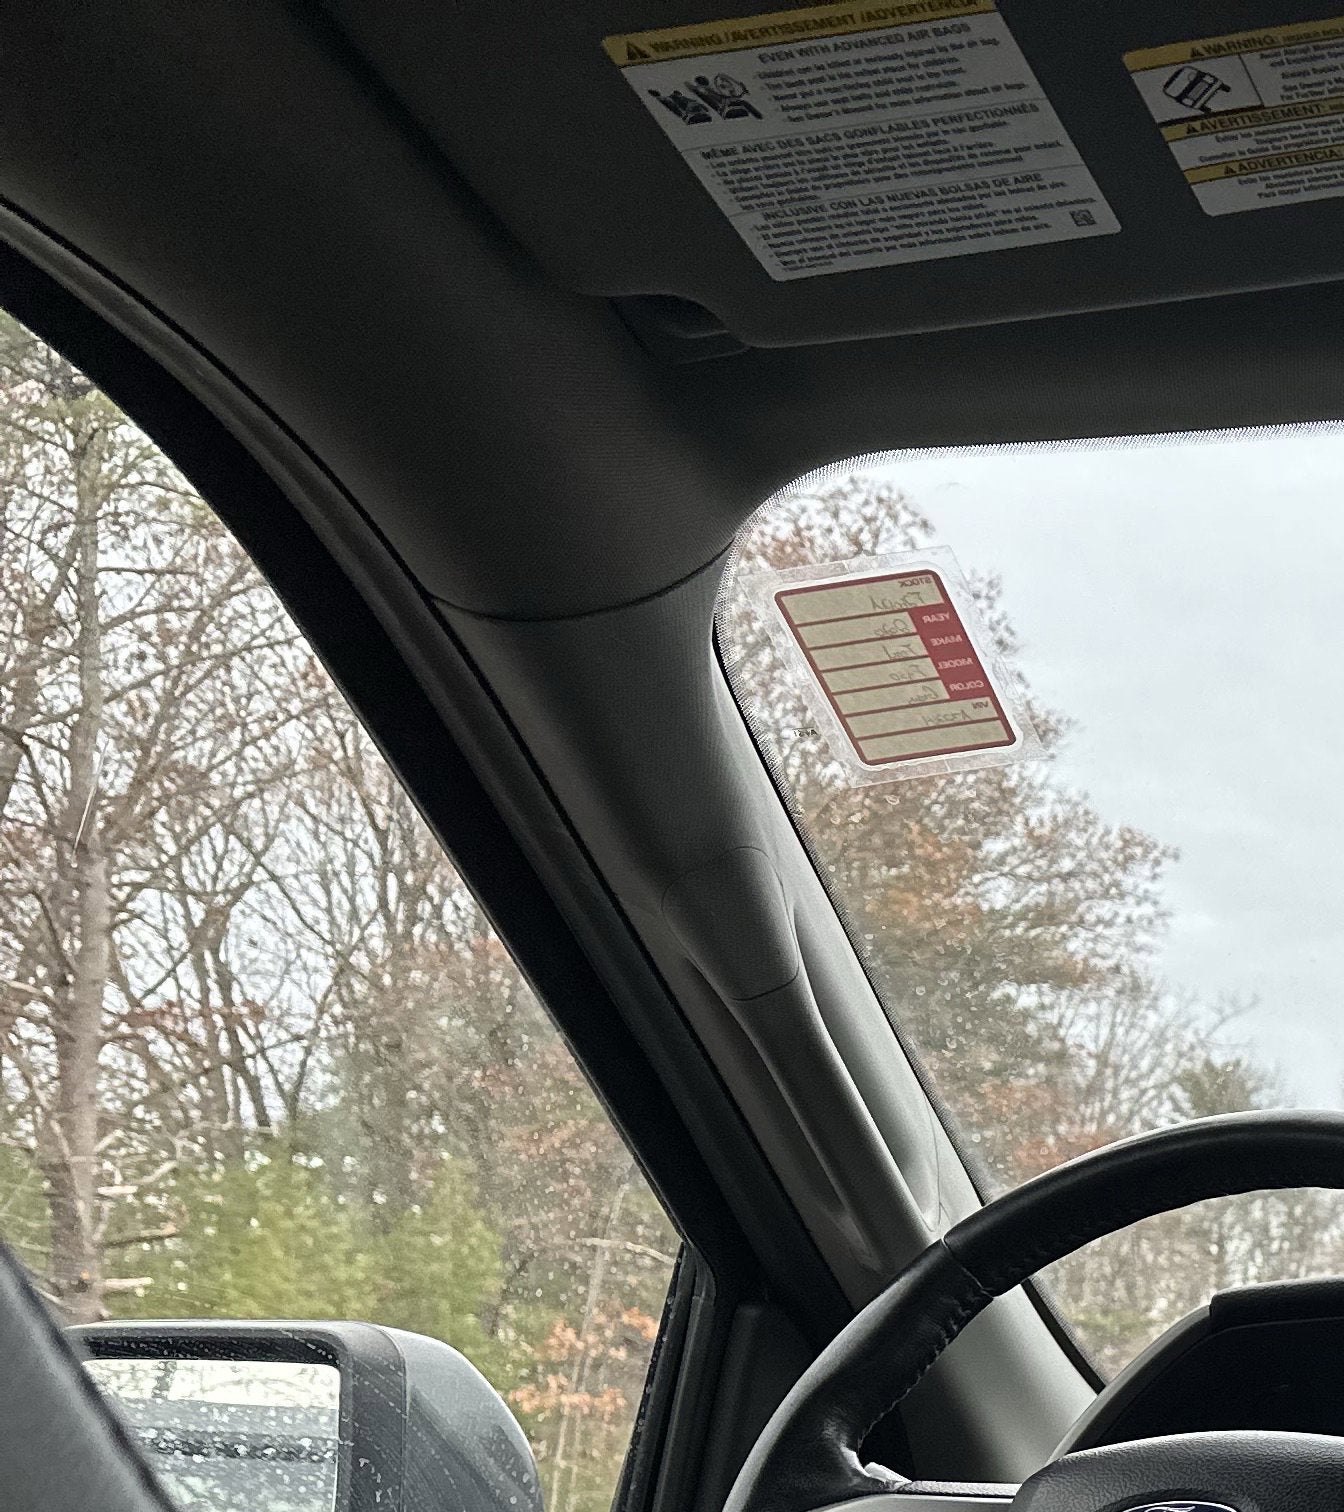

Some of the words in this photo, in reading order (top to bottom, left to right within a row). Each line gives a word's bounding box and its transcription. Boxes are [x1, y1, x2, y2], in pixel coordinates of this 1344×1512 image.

[649, 33, 722, 53] WARNING
[758, 49, 795, 63] EVEN
[796, 44, 832, 57] WITH
[833, 33, 905, 53] ADVANCED
[907, 28, 931, 41] AIR
[931, 22, 971, 37] BAGS
[741, 140, 776, 154] AVEC
[777, 136, 804, 149] DES
[805, 131, 842, 145] SACS
[843, 119, 931, 140] GONFLABLES
[762, 203, 828, 222] INCLUSIVE
[829, 199, 858, 212] CON
[860, 195, 885, 207] LAS
[887, 185, 938, 202] NUEVAS
[939, 179, 992, 197] BOLSAS
[992, 177, 1010, 189] DE
[1013, 172, 1043, 185] AIRE
